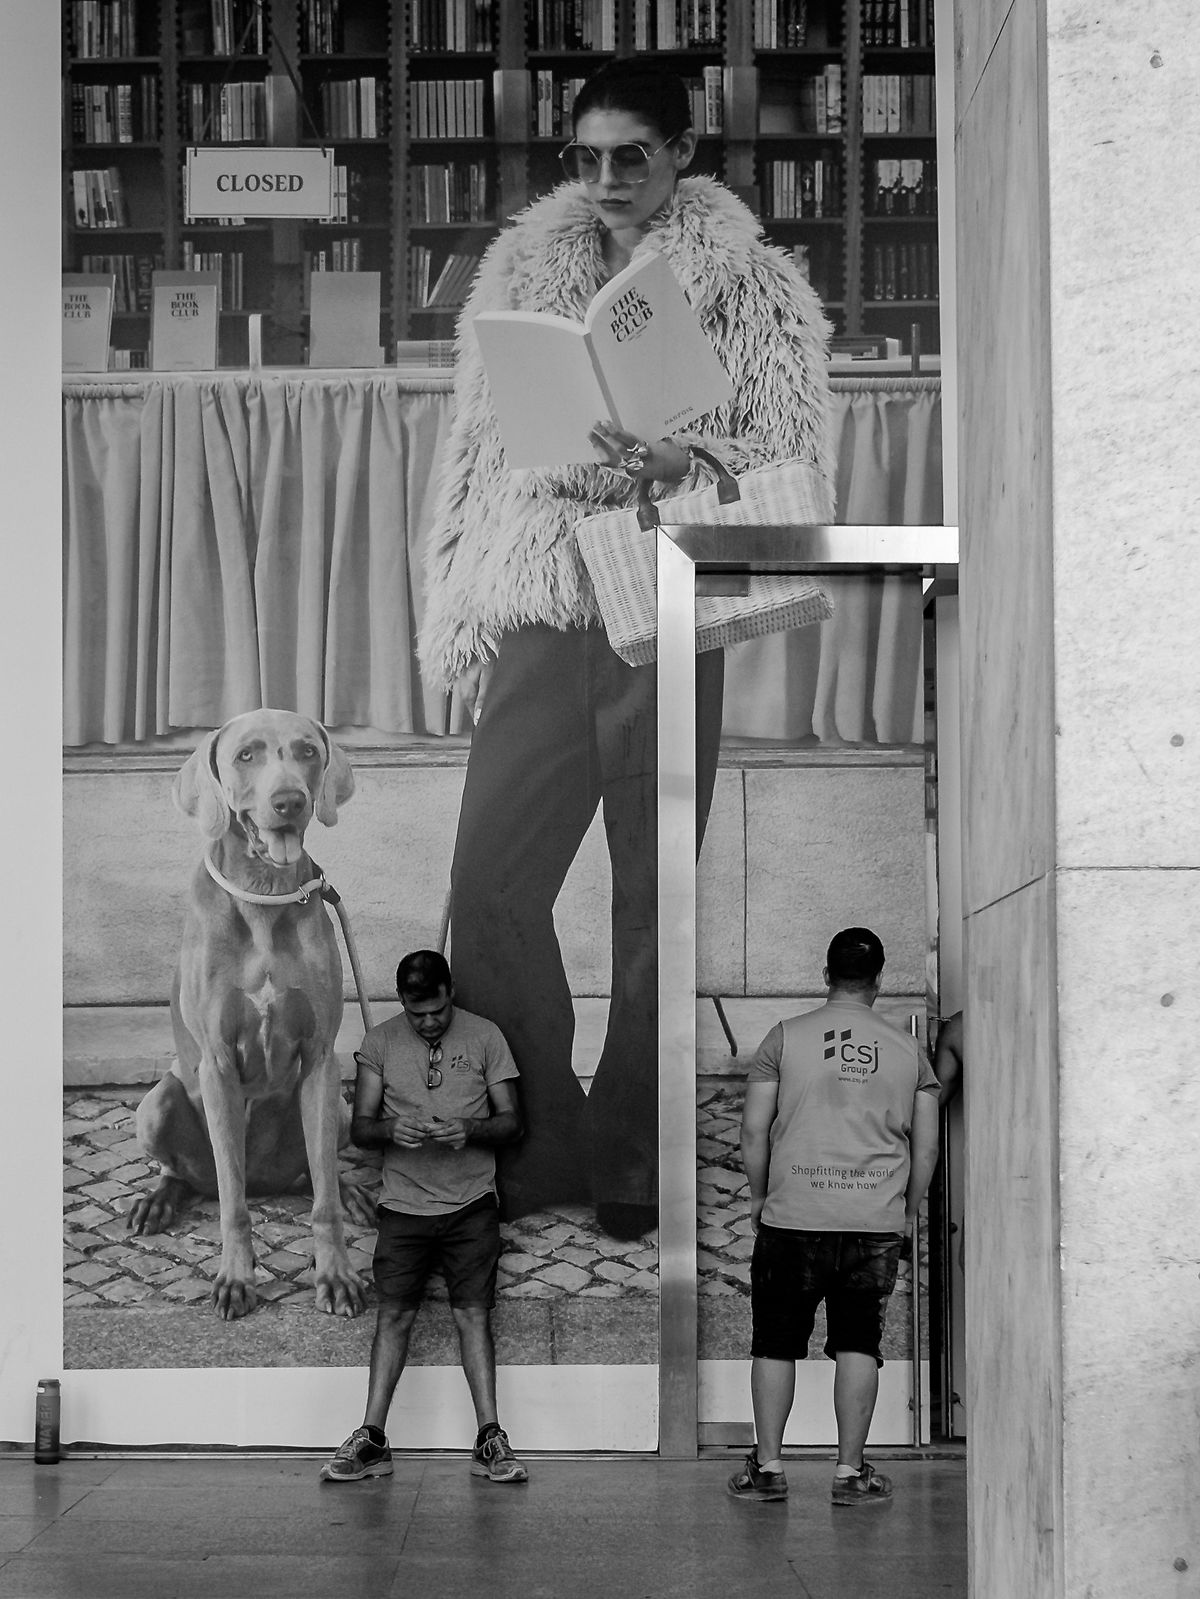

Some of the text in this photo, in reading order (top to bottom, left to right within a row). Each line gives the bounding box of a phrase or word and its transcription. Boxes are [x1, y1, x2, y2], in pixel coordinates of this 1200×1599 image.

[216, 174, 304, 192] CLOSED
[175, 292, 196, 301] THE
[610, 286, 639, 316] THE
[64, 302, 92, 310] BOOK
[170, 301, 199, 309] BOOK
[611, 295, 649, 334] BOOK
[616, 307, 653, 342] CLUB
[841, 1063, 868, 1076] Group
[791, 1165, 895, 1180] Shopfitting the world
[810, 1180, 878, 1190] we know how
